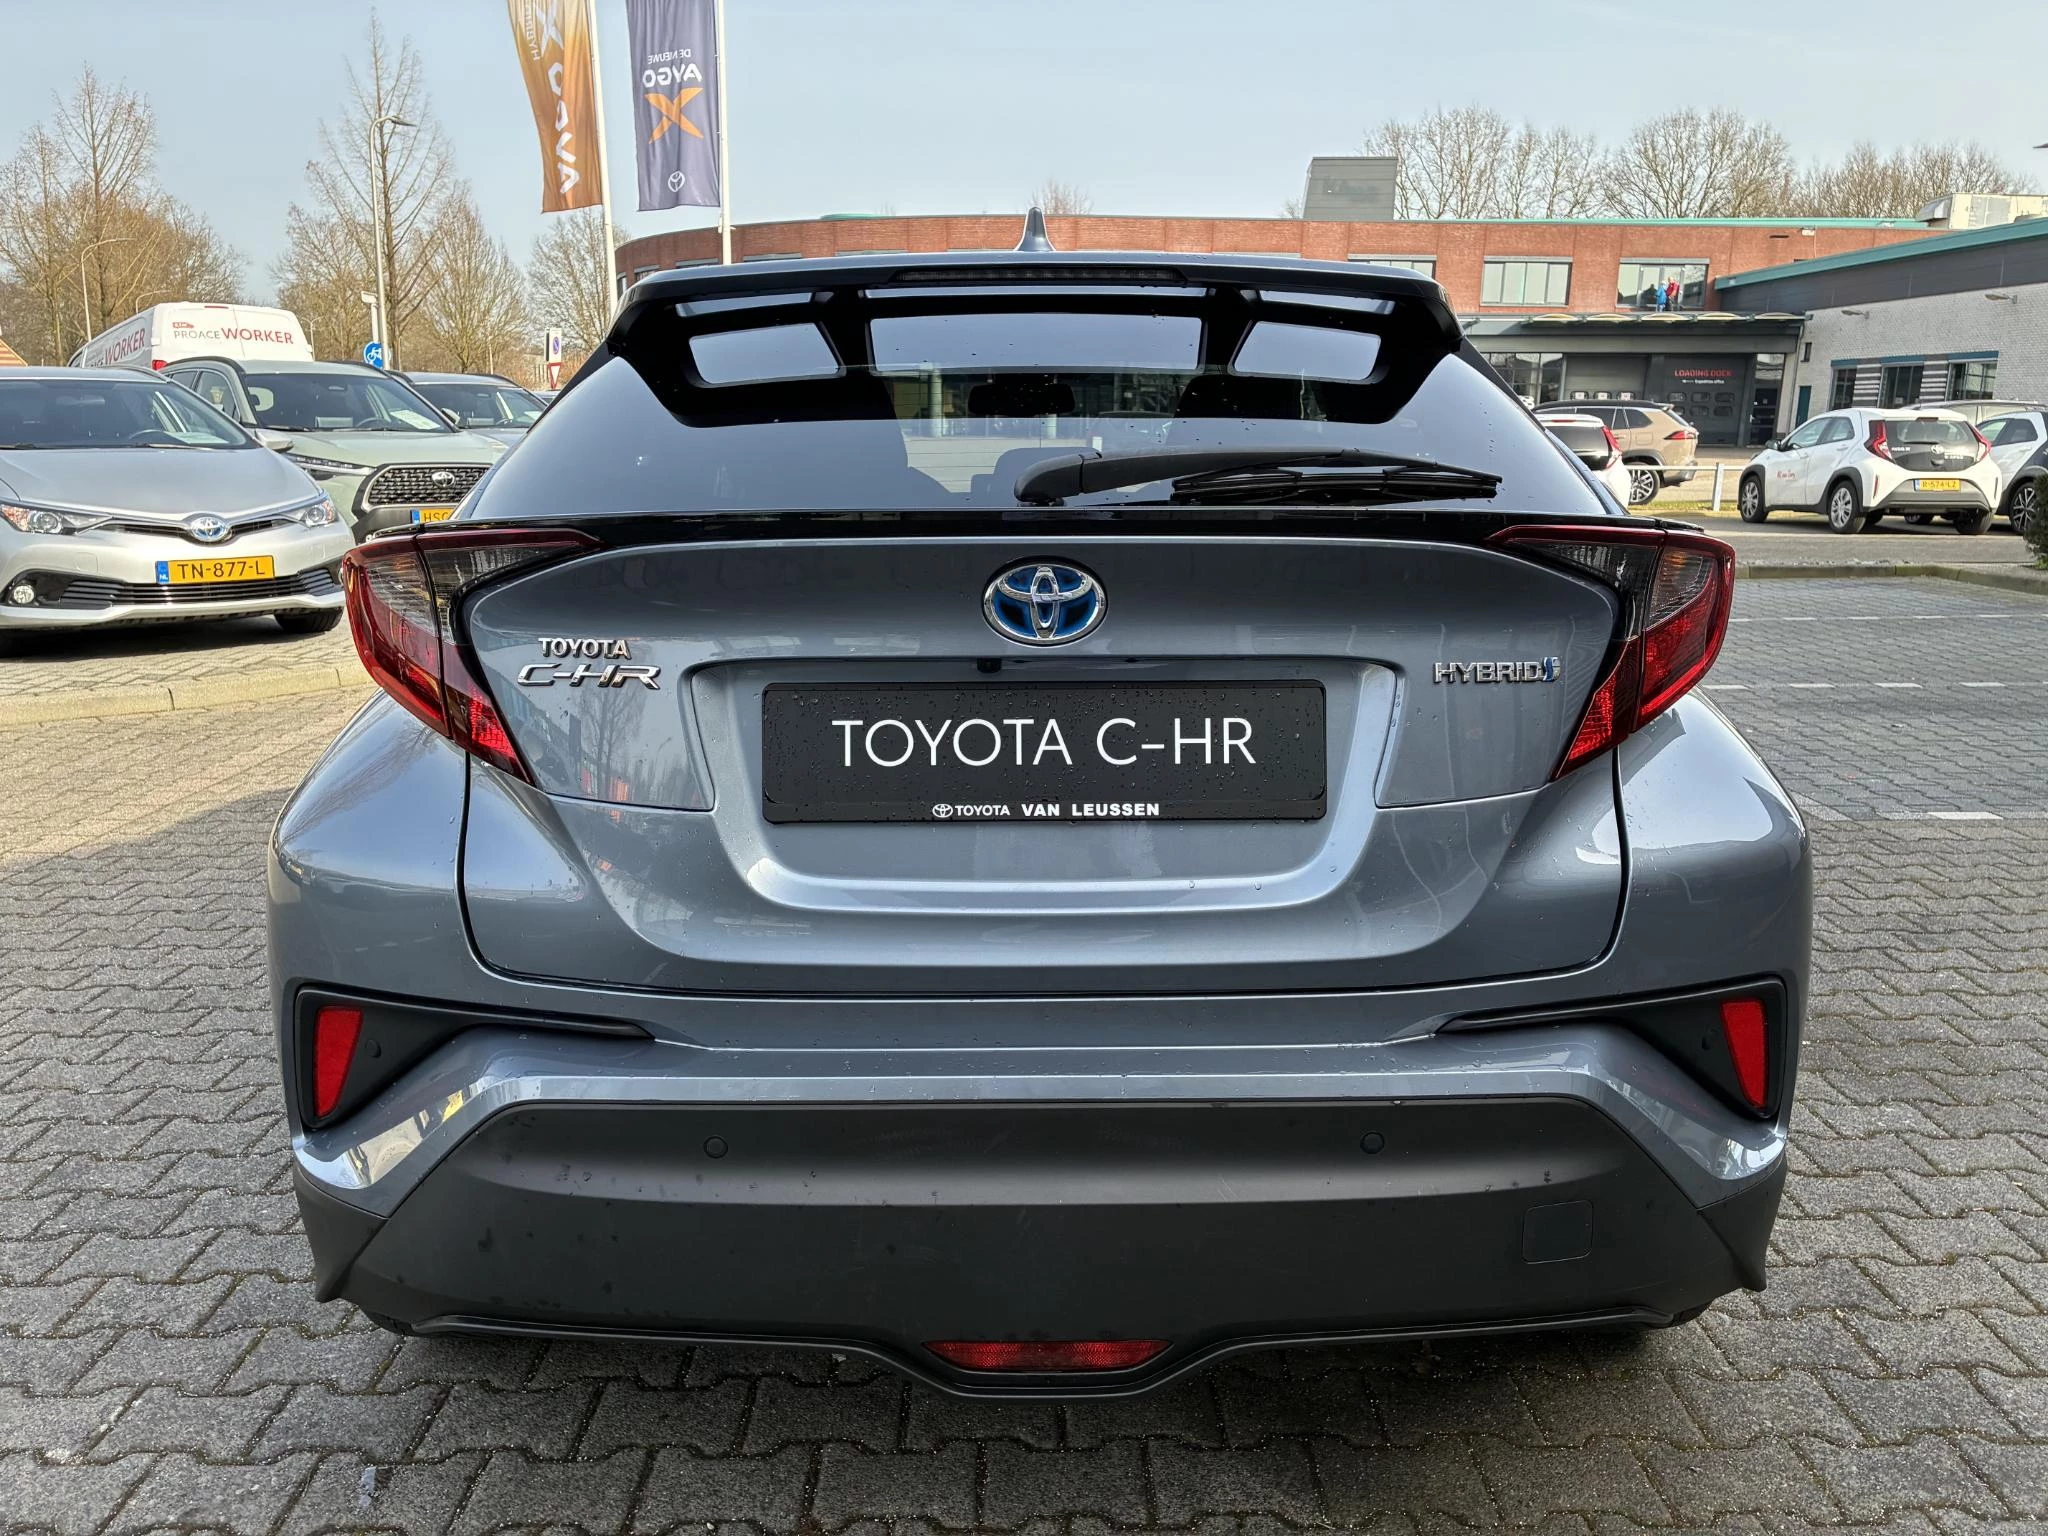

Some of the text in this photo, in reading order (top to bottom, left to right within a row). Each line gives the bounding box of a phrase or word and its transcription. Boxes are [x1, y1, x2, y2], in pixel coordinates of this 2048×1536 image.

[105, 327, 146, 366] WORKER
[173, 327, 294, 345] PROACE WORKER
[1674, 369, 1709, 377] LOADING
[177, 560, 265, 579] TN-877-L
[538, 637, 631, 660] TOYOTA
[517, 662, 661, 690] C-HR
[1433, 661, 1542, 683] HYBRID
[831, 717, 1257, 768] TOYOTA C-HR
[954, 803, 1160, 817] TOYOTA VAN LEUSSEN
